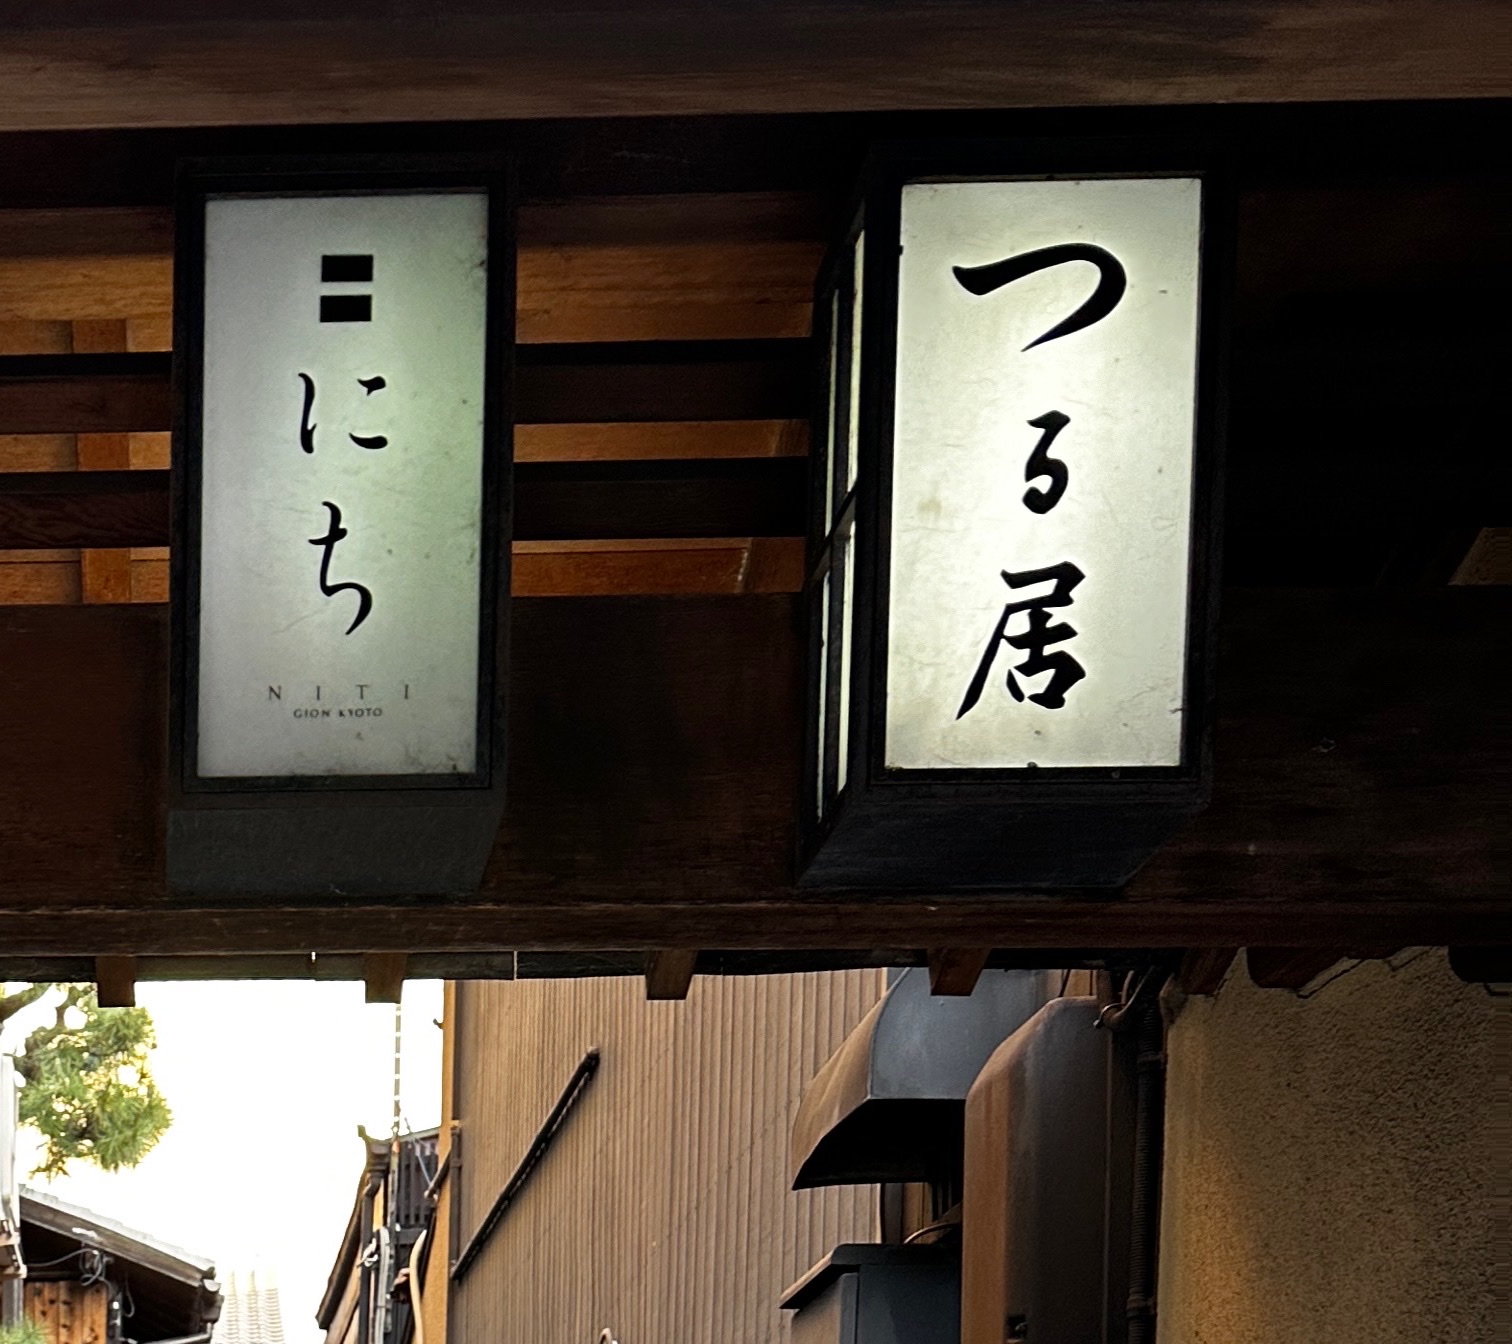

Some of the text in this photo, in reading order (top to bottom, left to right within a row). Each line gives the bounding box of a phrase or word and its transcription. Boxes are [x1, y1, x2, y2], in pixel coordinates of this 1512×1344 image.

[296, 371, 389, 636] にち
[951, 242, 1128, 721] つる居
[268, 684, 410, 701] NITI
[293, 708, 331, 719] GION
